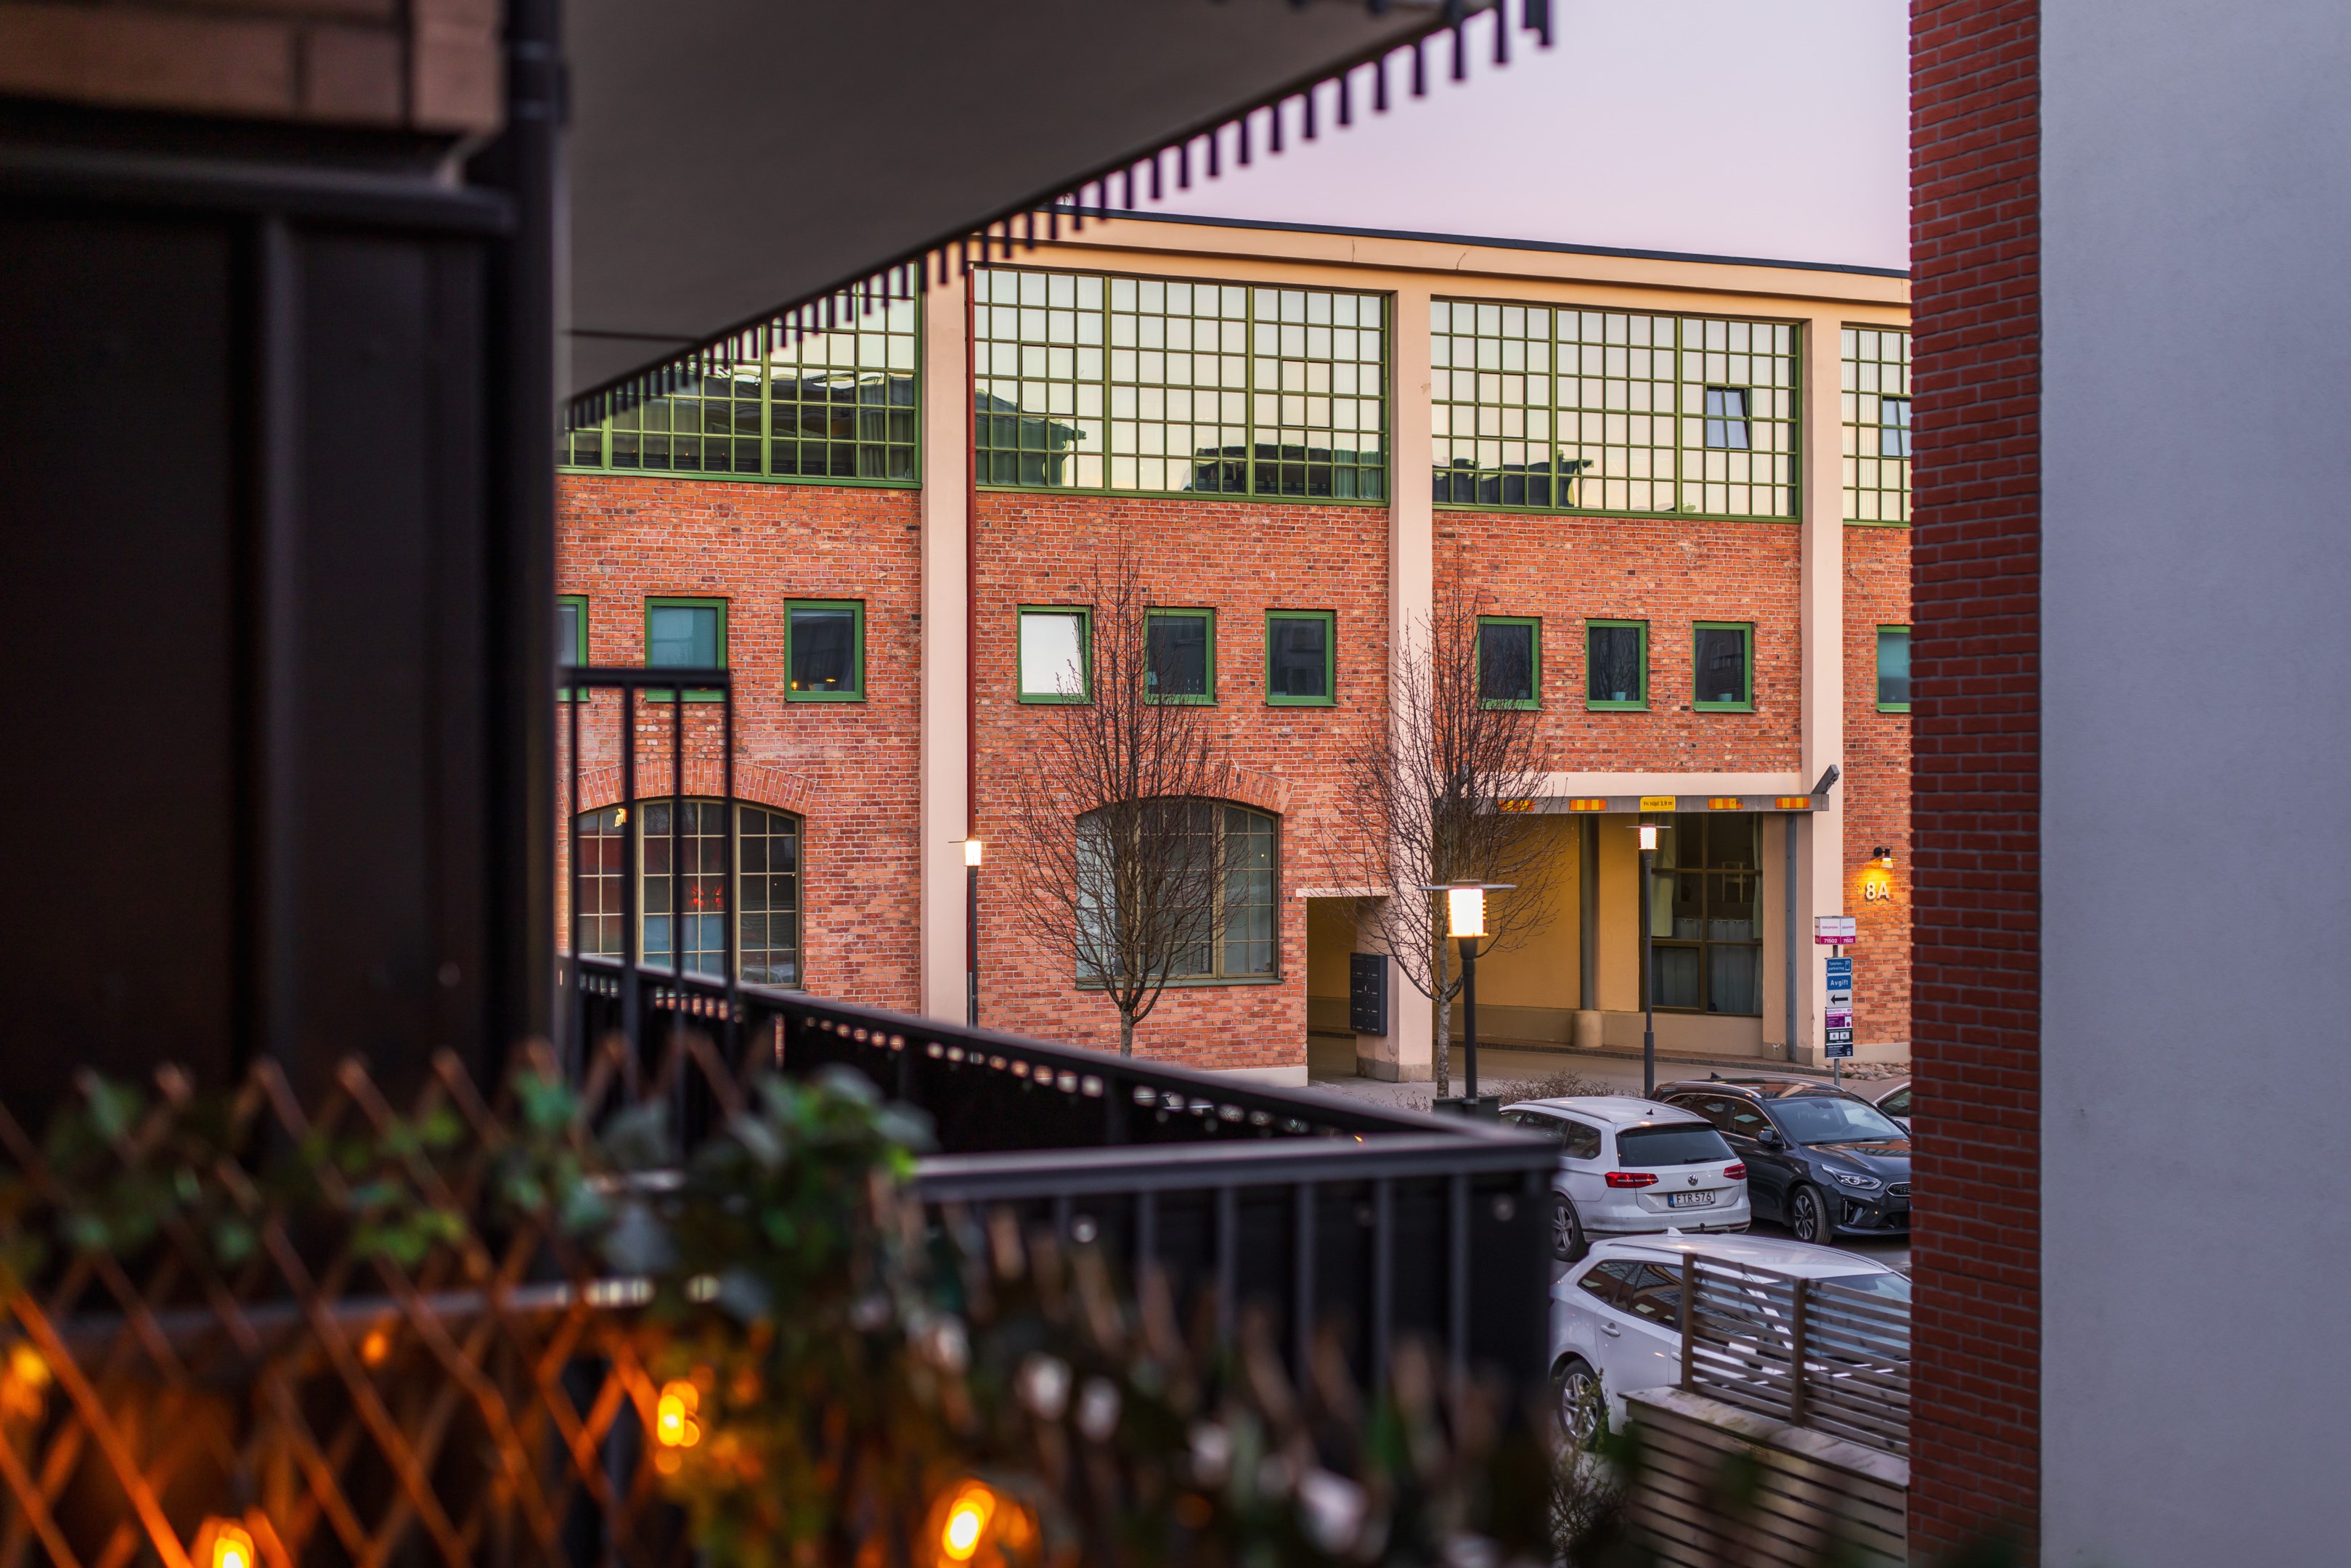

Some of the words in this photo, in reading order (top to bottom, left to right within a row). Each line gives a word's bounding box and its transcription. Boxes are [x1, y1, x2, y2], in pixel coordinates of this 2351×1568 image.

[1865, 881, 1890, 900] 8A
[1830, 979, 1849, 987] Avgift
[1676, 1193, 1693, 1204] FTR
[1695, 1192, 1711, 1202] 576
